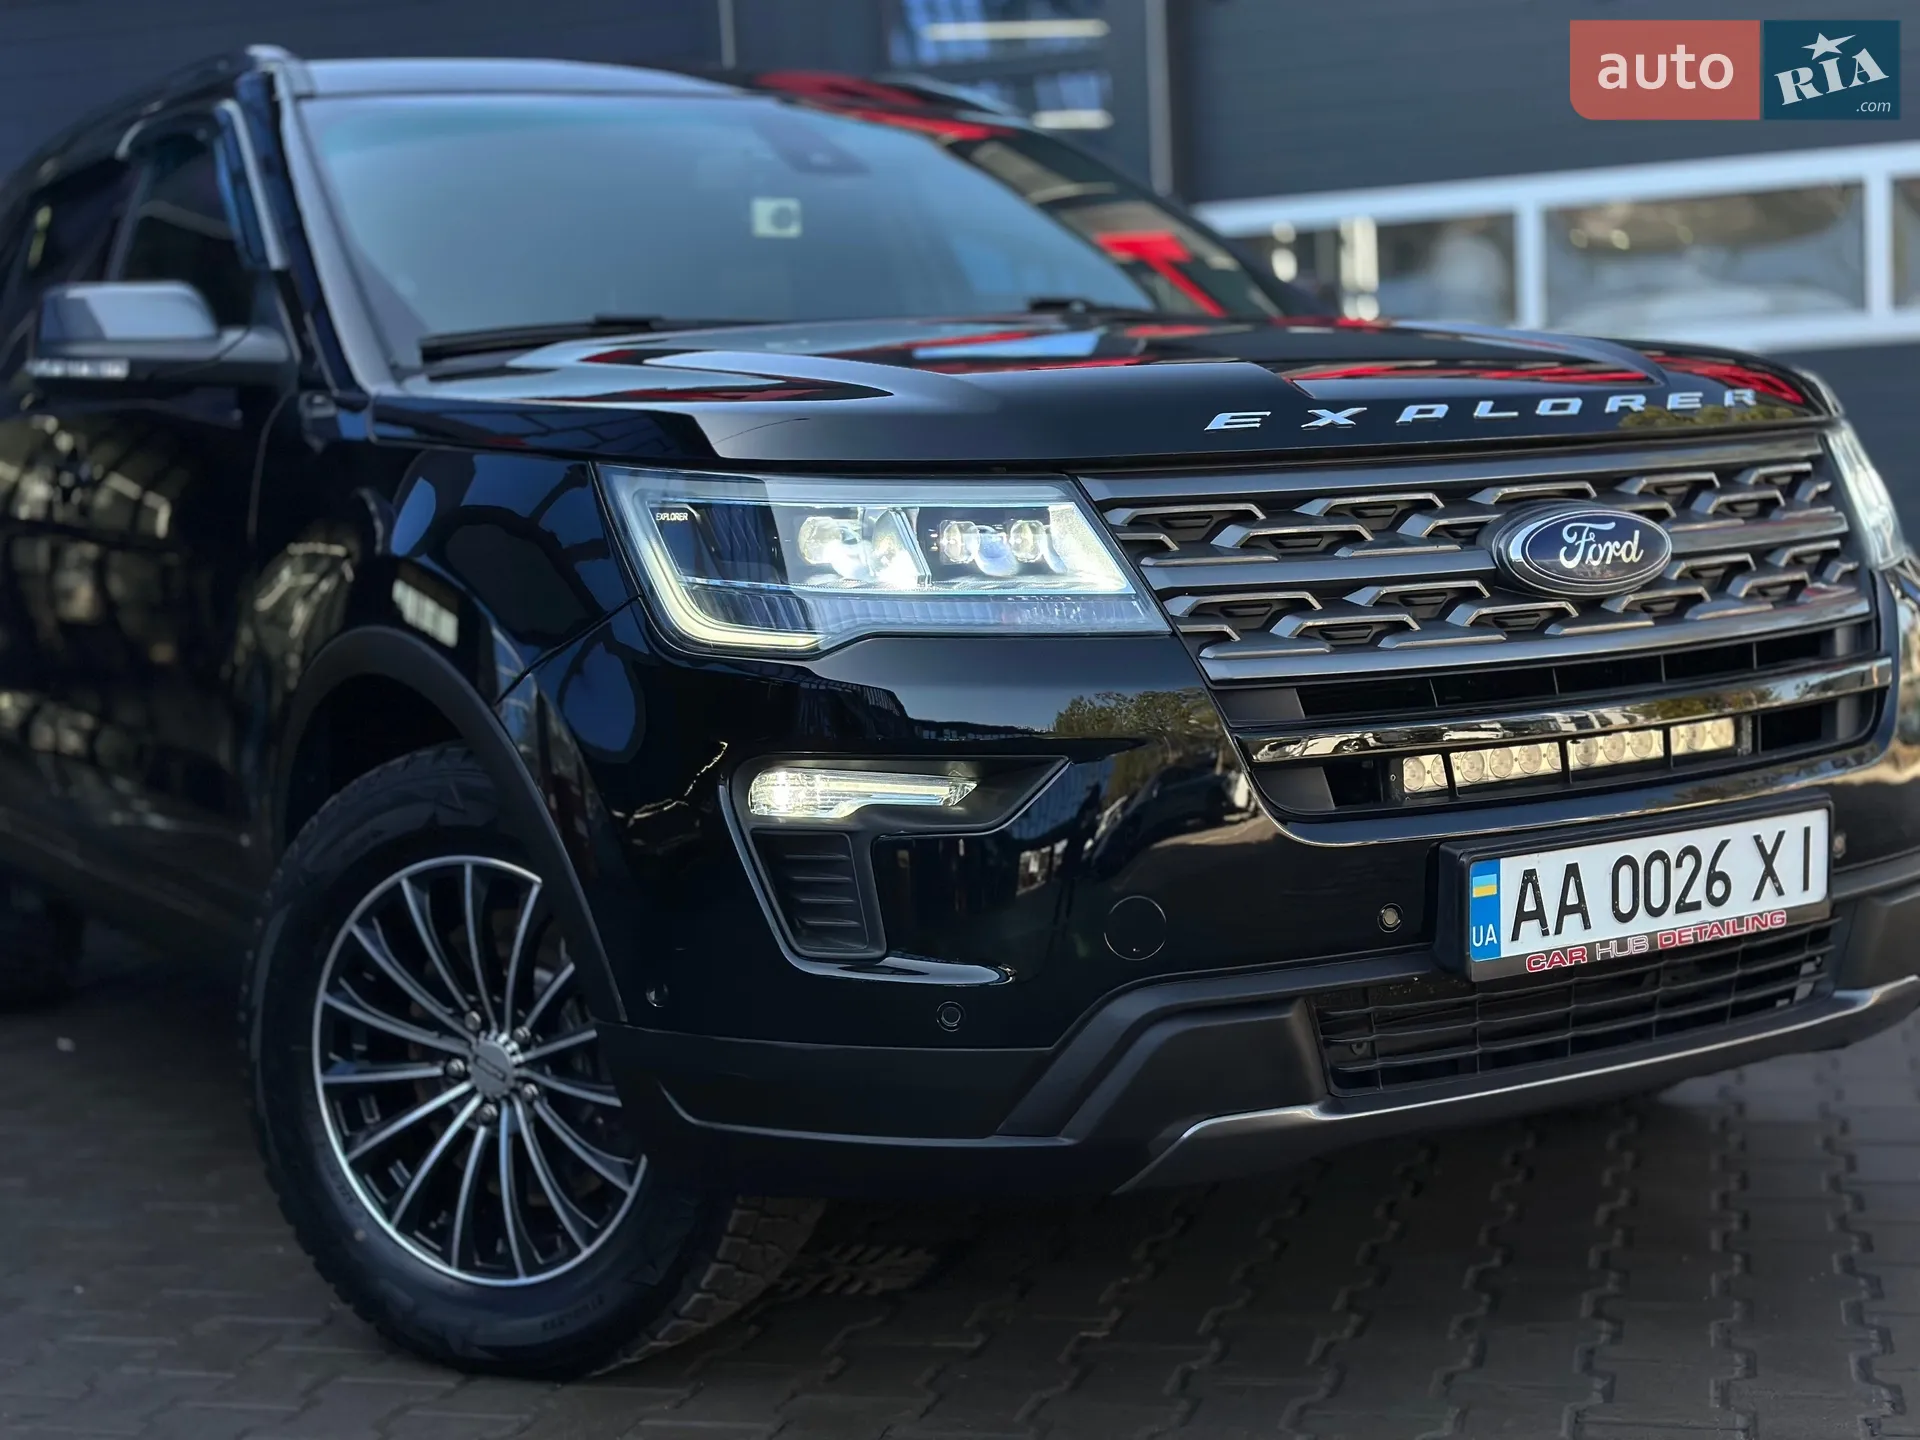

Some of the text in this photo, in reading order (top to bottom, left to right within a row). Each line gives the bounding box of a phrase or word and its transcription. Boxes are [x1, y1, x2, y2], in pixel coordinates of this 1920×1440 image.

[1204, 388, 1758, 431] EXPLORER
[656, 512, 688, 521] EXPLORER
[1558, 521, 1645, 569] Ford
[1510, 862, 1592, 942] AA
[1611, 838, 1732, 923] 0026
[1472, 924, 1498, 947] UA
[1525, 910, 1787, 973] CAR HUB DETAILING
